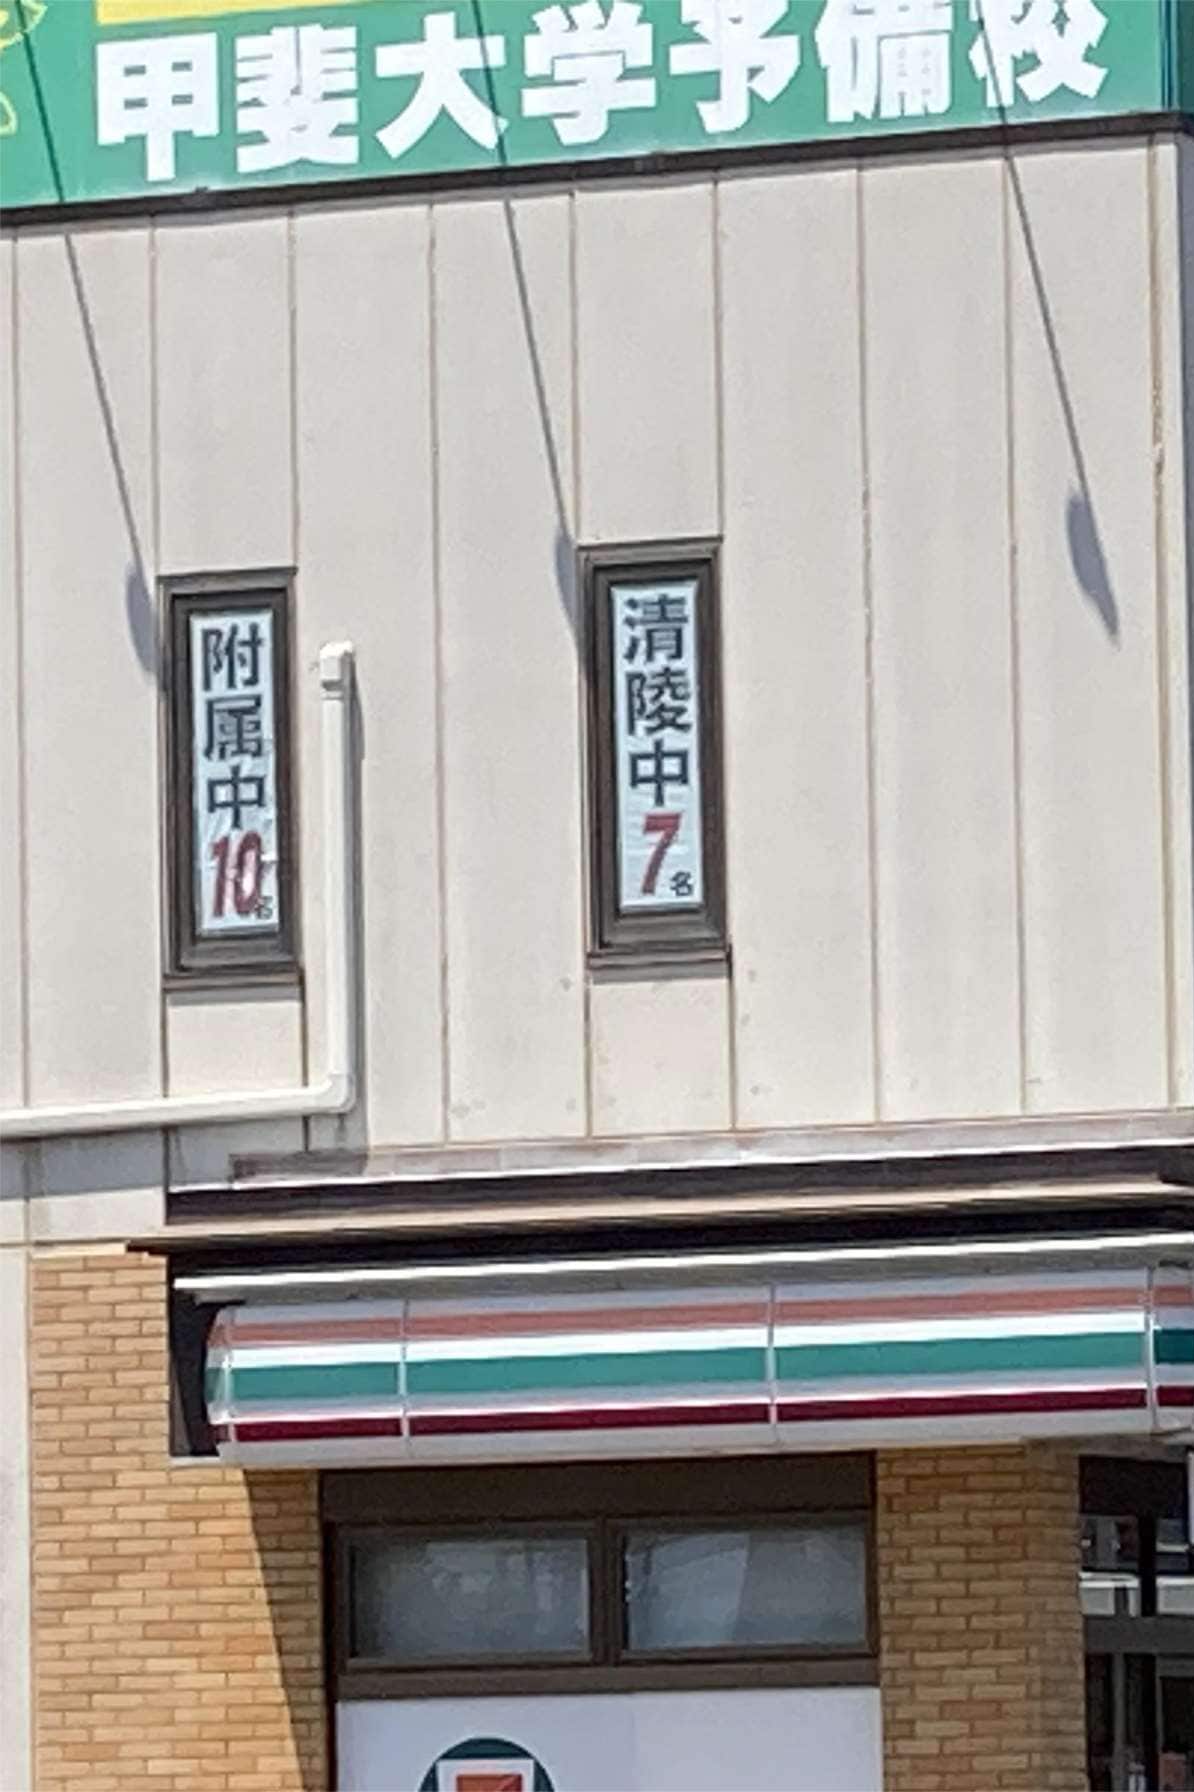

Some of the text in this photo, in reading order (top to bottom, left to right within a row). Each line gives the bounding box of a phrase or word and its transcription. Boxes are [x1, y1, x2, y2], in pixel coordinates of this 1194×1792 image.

[96, 0, 1109, 182] 甲斐大学予備校
